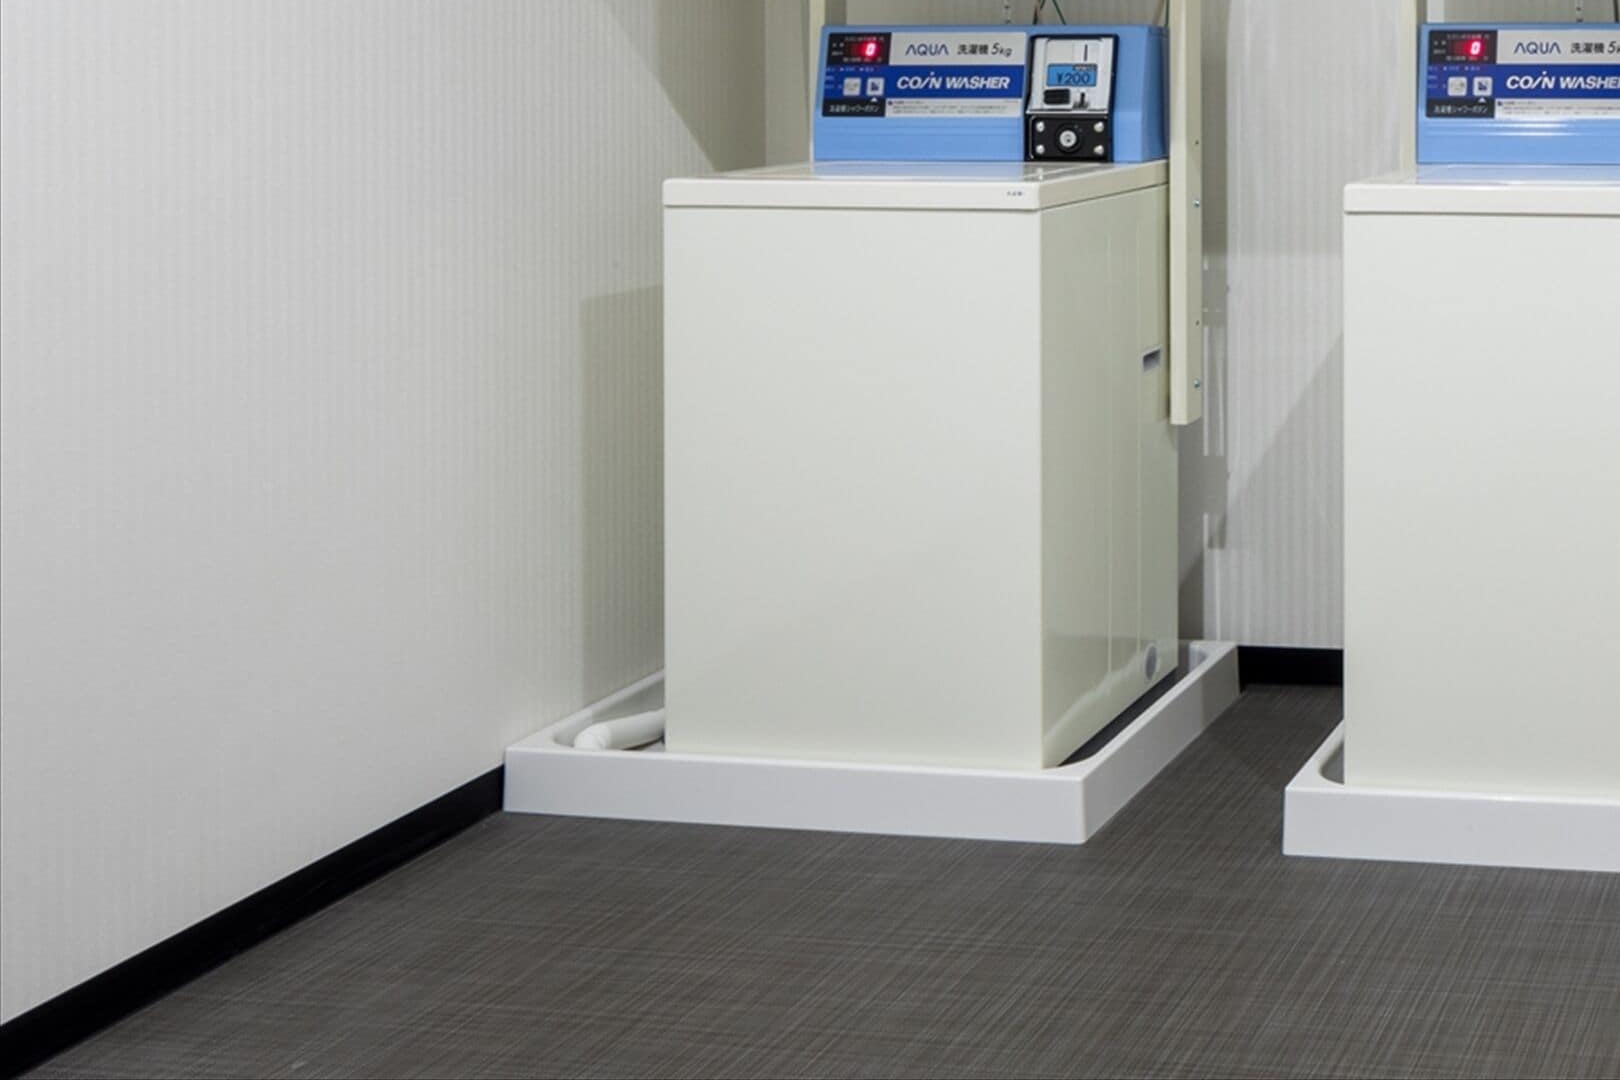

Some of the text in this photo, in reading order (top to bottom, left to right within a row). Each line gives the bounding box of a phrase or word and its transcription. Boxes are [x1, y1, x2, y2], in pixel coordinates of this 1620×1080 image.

[905, 43, 949, 56] AQUA
[957, 42, 1013, 58] 洗濯機 5kg
[1513, 41, 1561, 55] AQUA
[1570, 41, 1605, 55] 洗濯機
[945, 76, 1011, 90] WASHER
